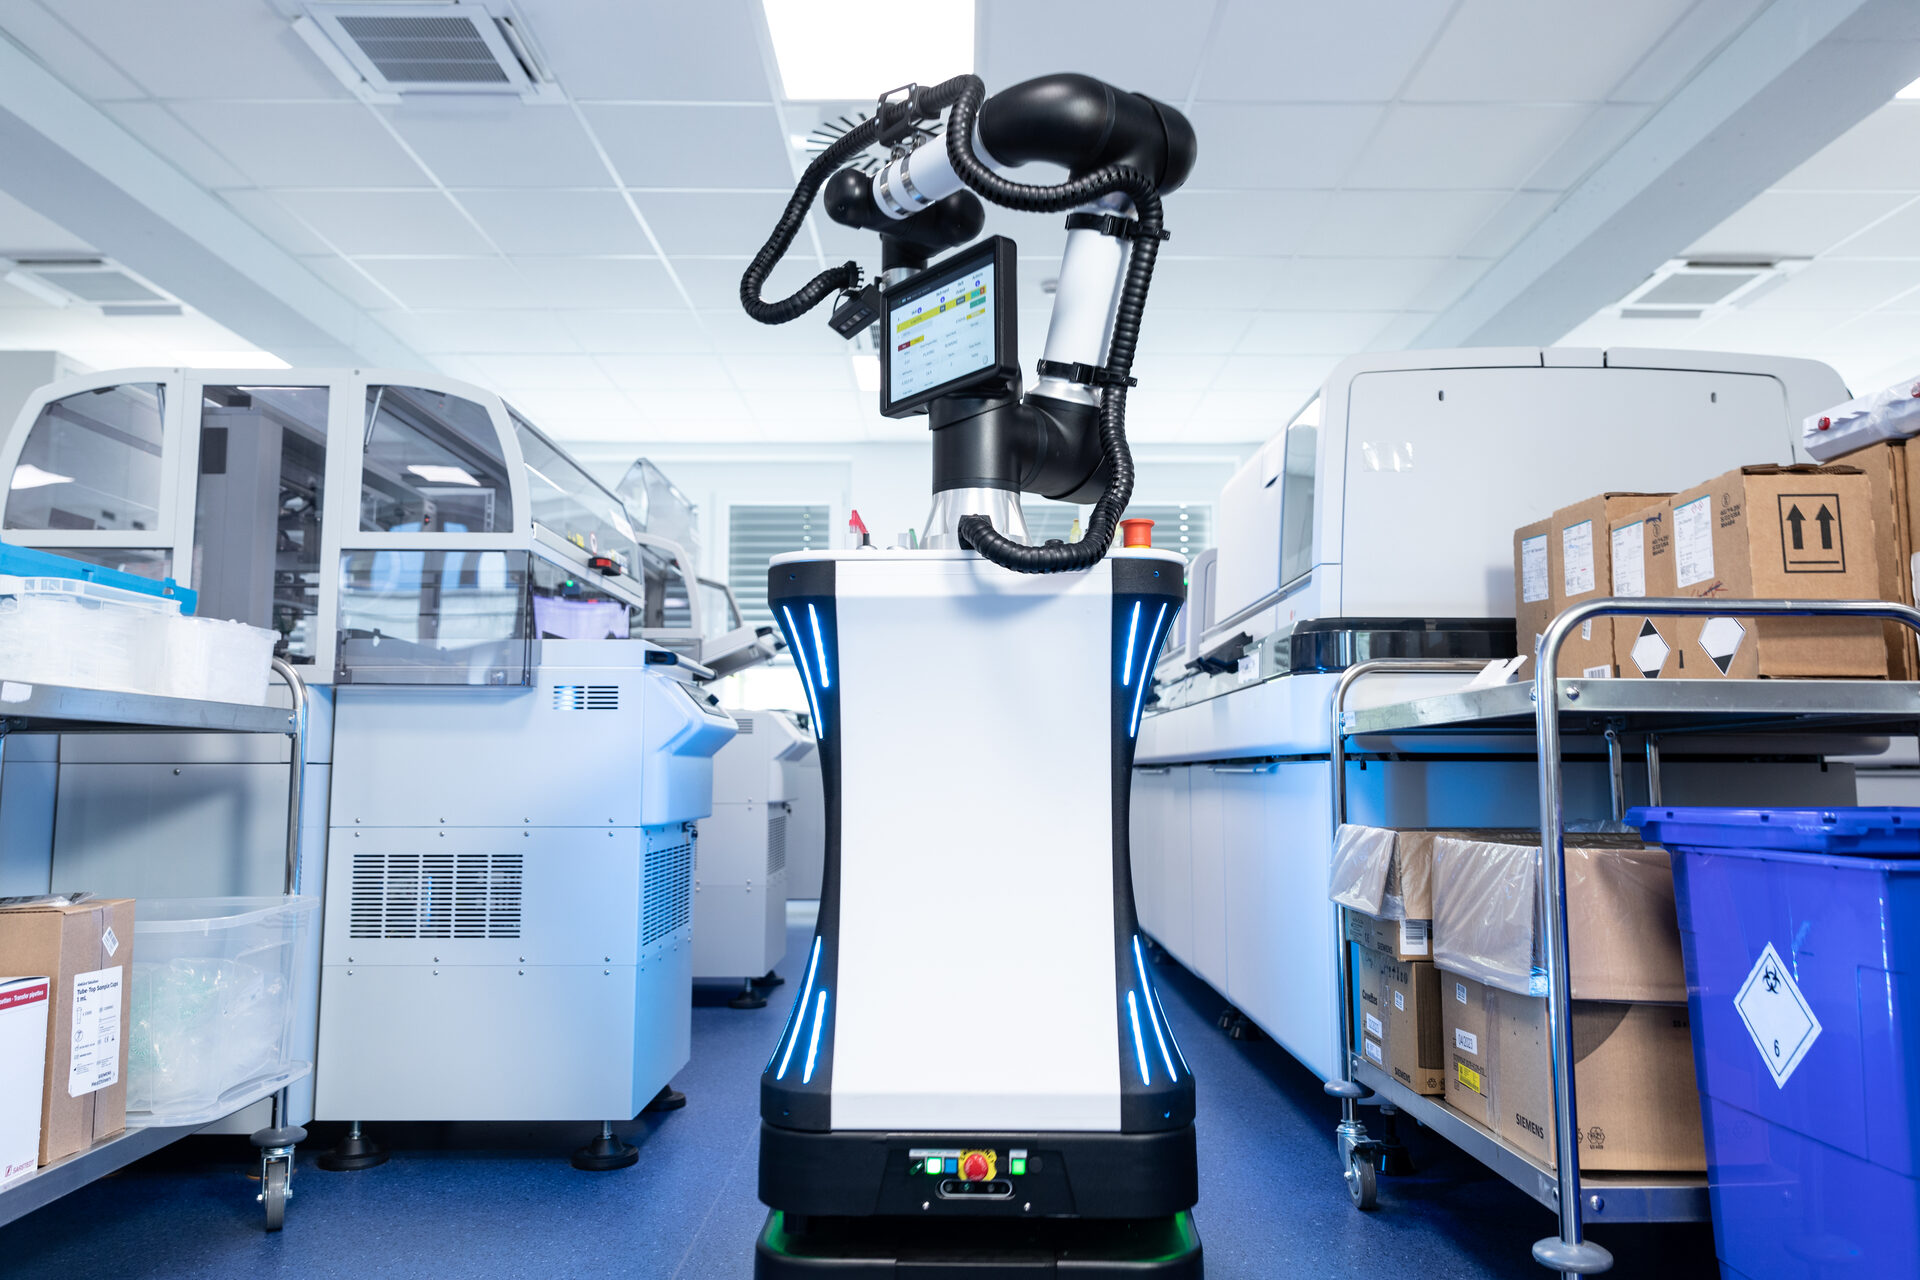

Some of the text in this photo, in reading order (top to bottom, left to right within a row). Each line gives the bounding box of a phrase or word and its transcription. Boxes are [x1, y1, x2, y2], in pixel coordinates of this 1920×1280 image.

[1377, 941, 1393, 954] SIEMENS
[97, 984, 109, 992] Sample
[14, 993, 29, 1002] Transfer
[1773, 1039, 1781, 1058] 6
[1394, 1066, 1411, 1084] SIEMENS
[1515, 1112, 1545, 1140] SIEMENS
